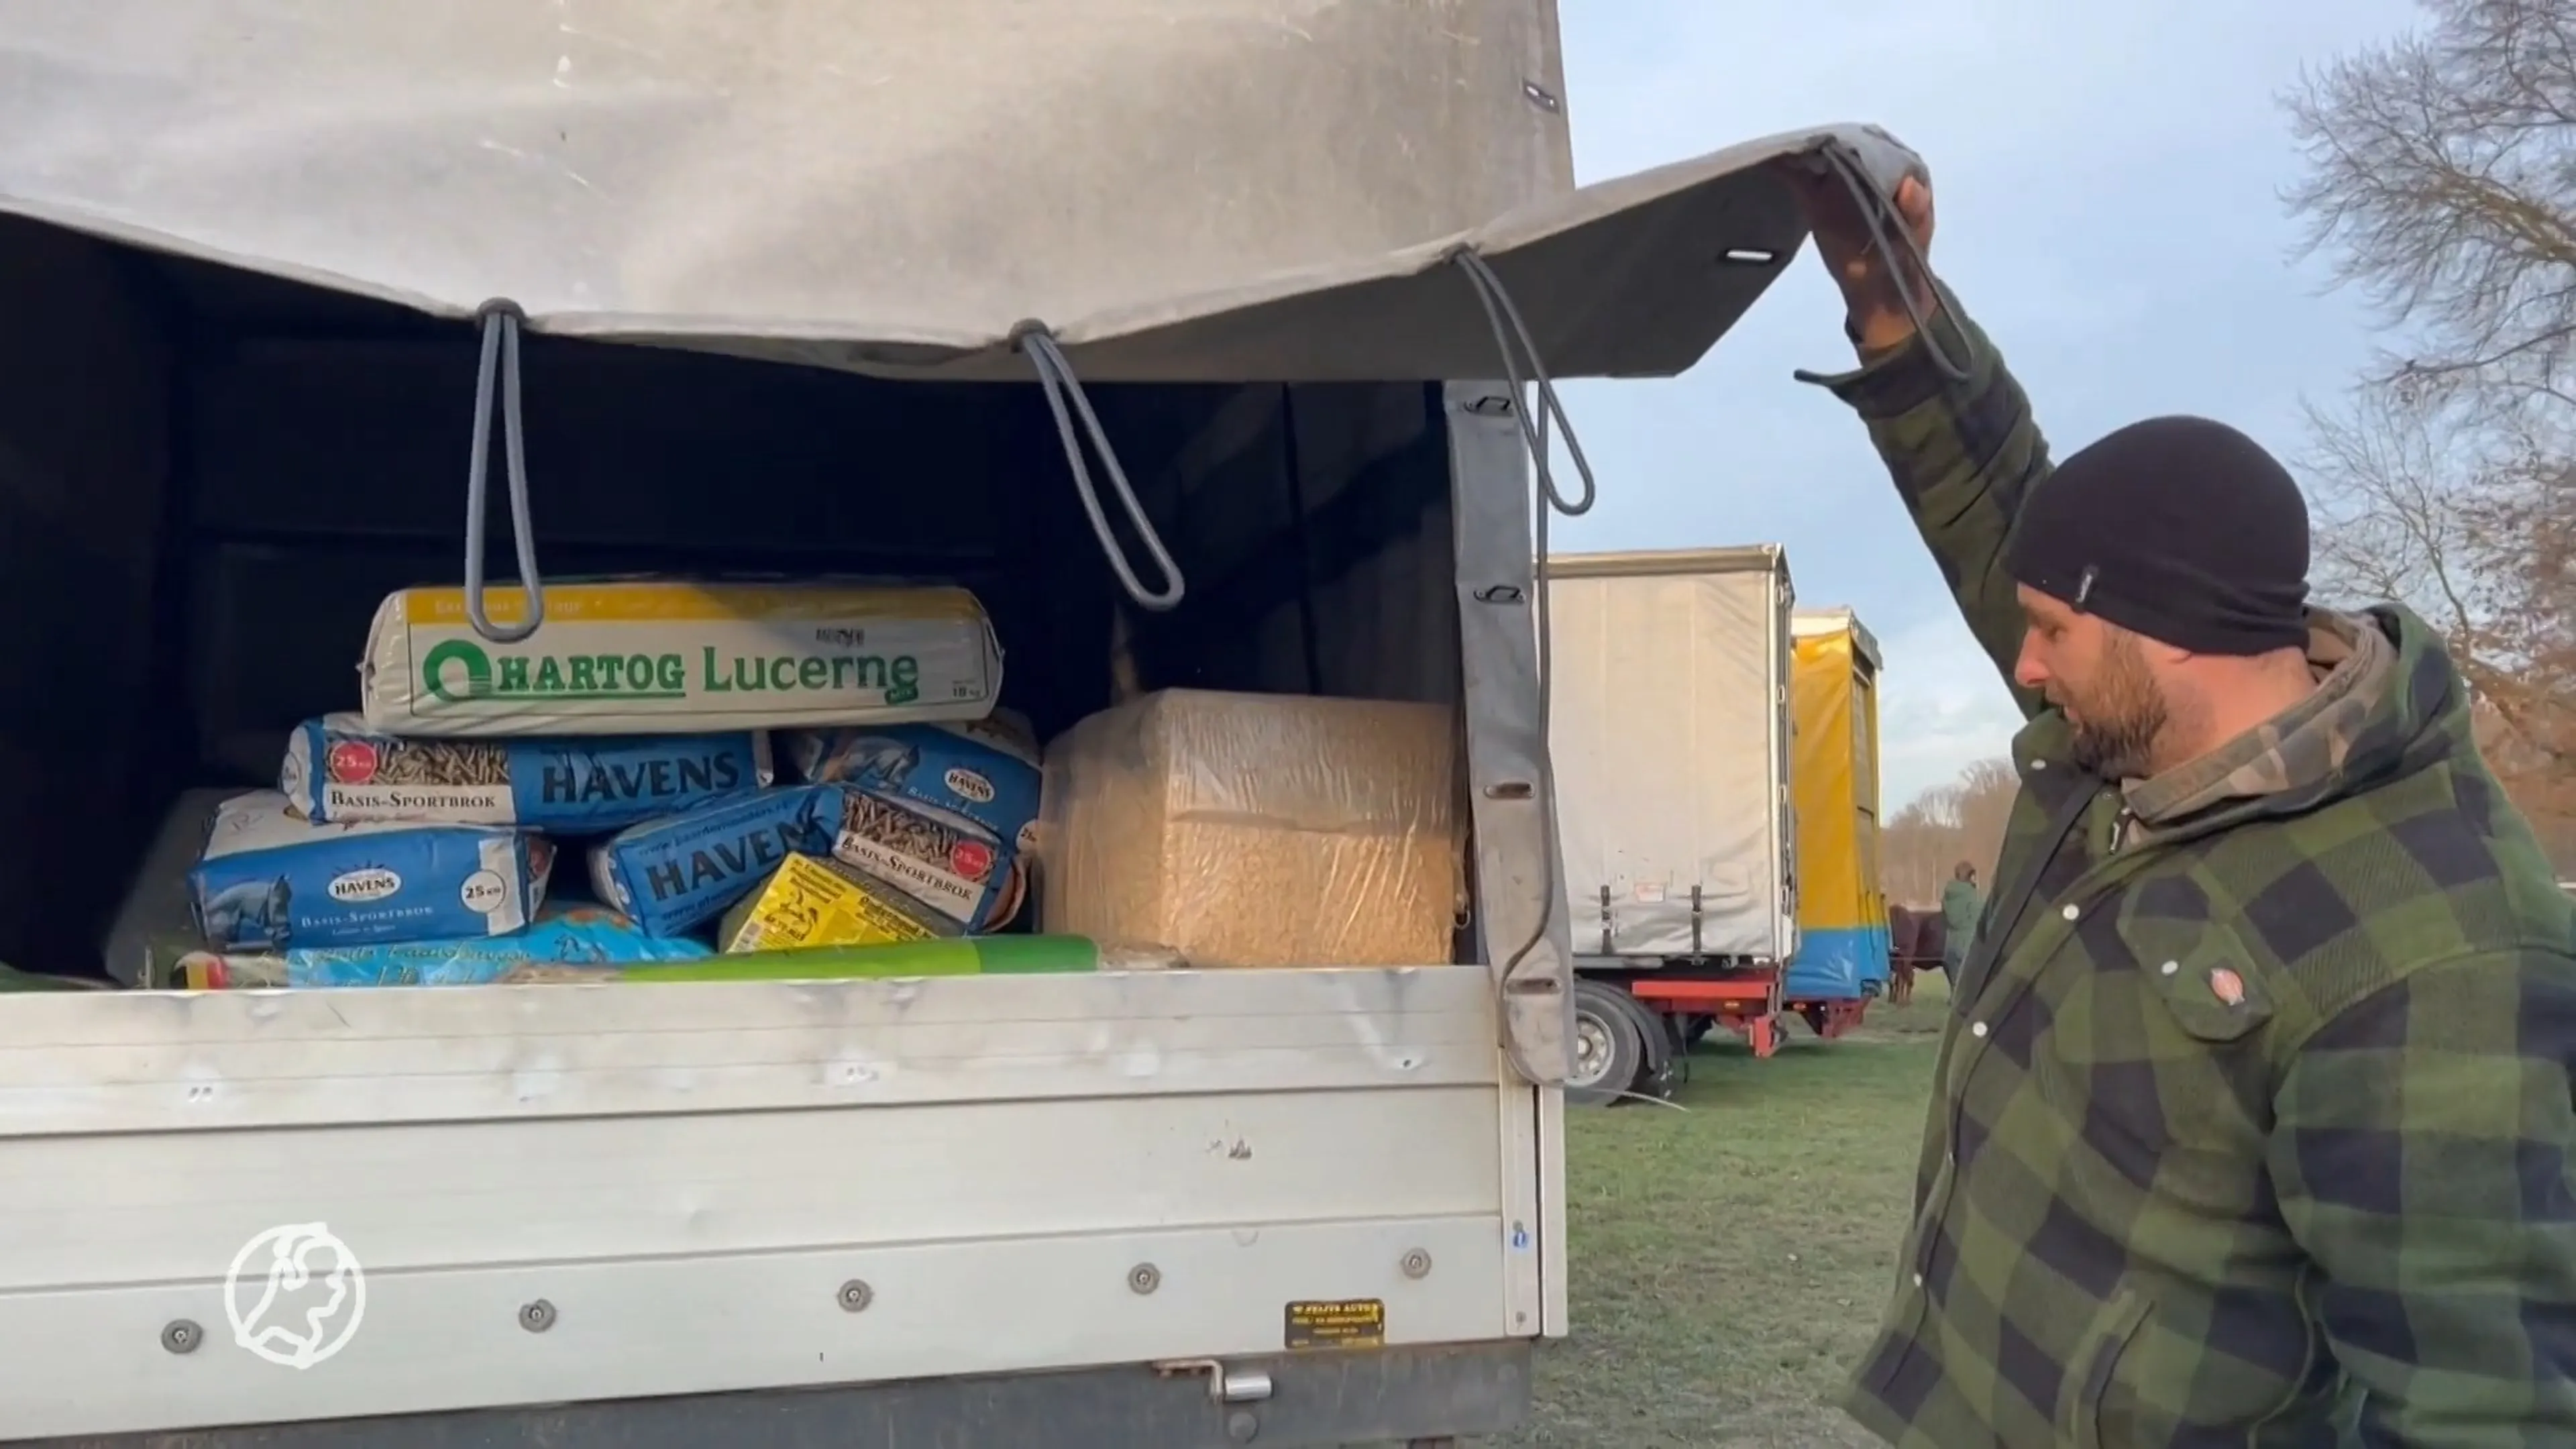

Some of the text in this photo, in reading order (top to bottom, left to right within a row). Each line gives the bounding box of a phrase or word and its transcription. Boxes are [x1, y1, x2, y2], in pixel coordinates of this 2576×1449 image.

[497, 645, 919, 692] HARTOG Lucerne
[542, 751, 739, 804] HAVENS
[645, 817, 808, 902] HAVEN
[335, 877, 396, 896] HAVENS
